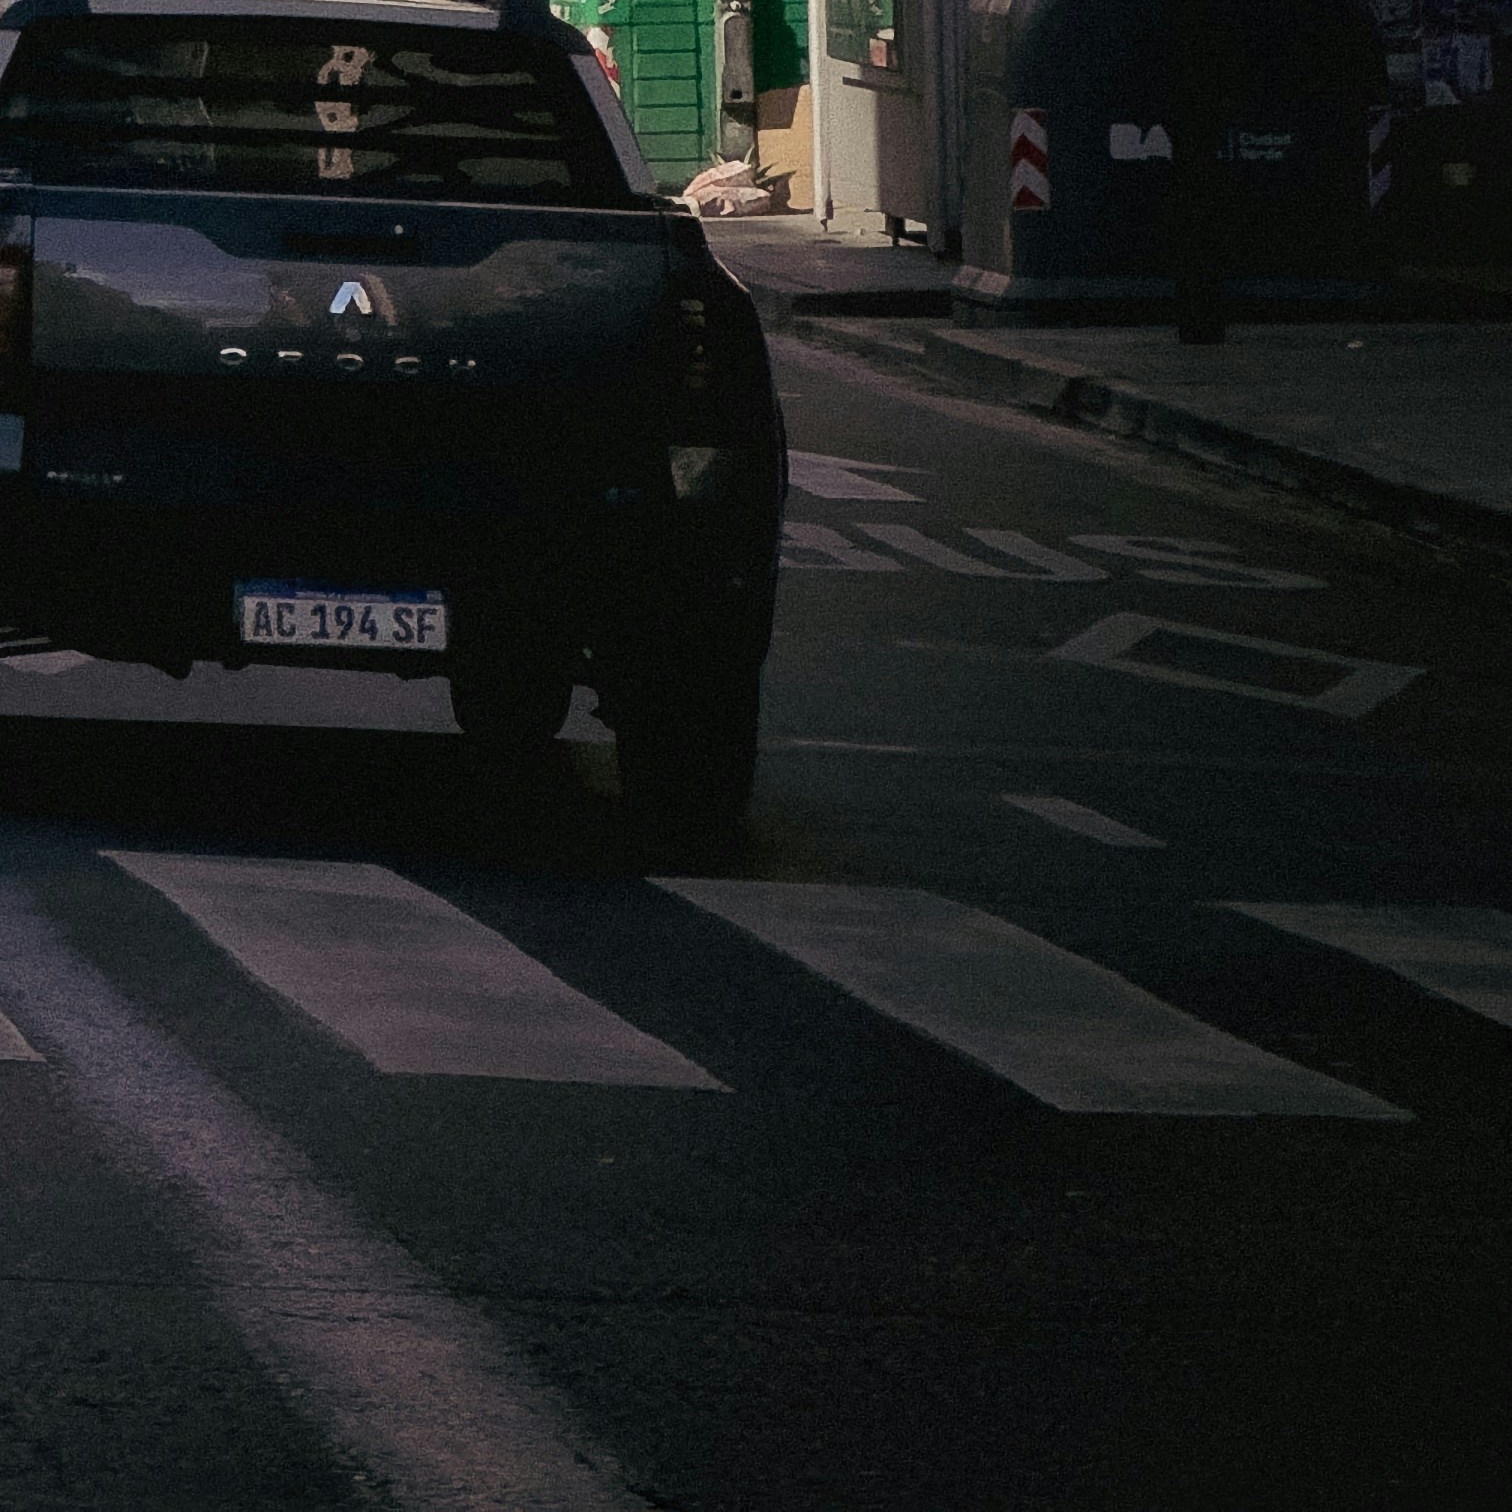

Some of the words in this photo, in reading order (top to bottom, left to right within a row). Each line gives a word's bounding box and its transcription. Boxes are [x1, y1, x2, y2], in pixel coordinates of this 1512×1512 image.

[253, 600, 297, 638] AC
[310, 603, 380, 641] 194
[391, 606, 439, 644] SF
